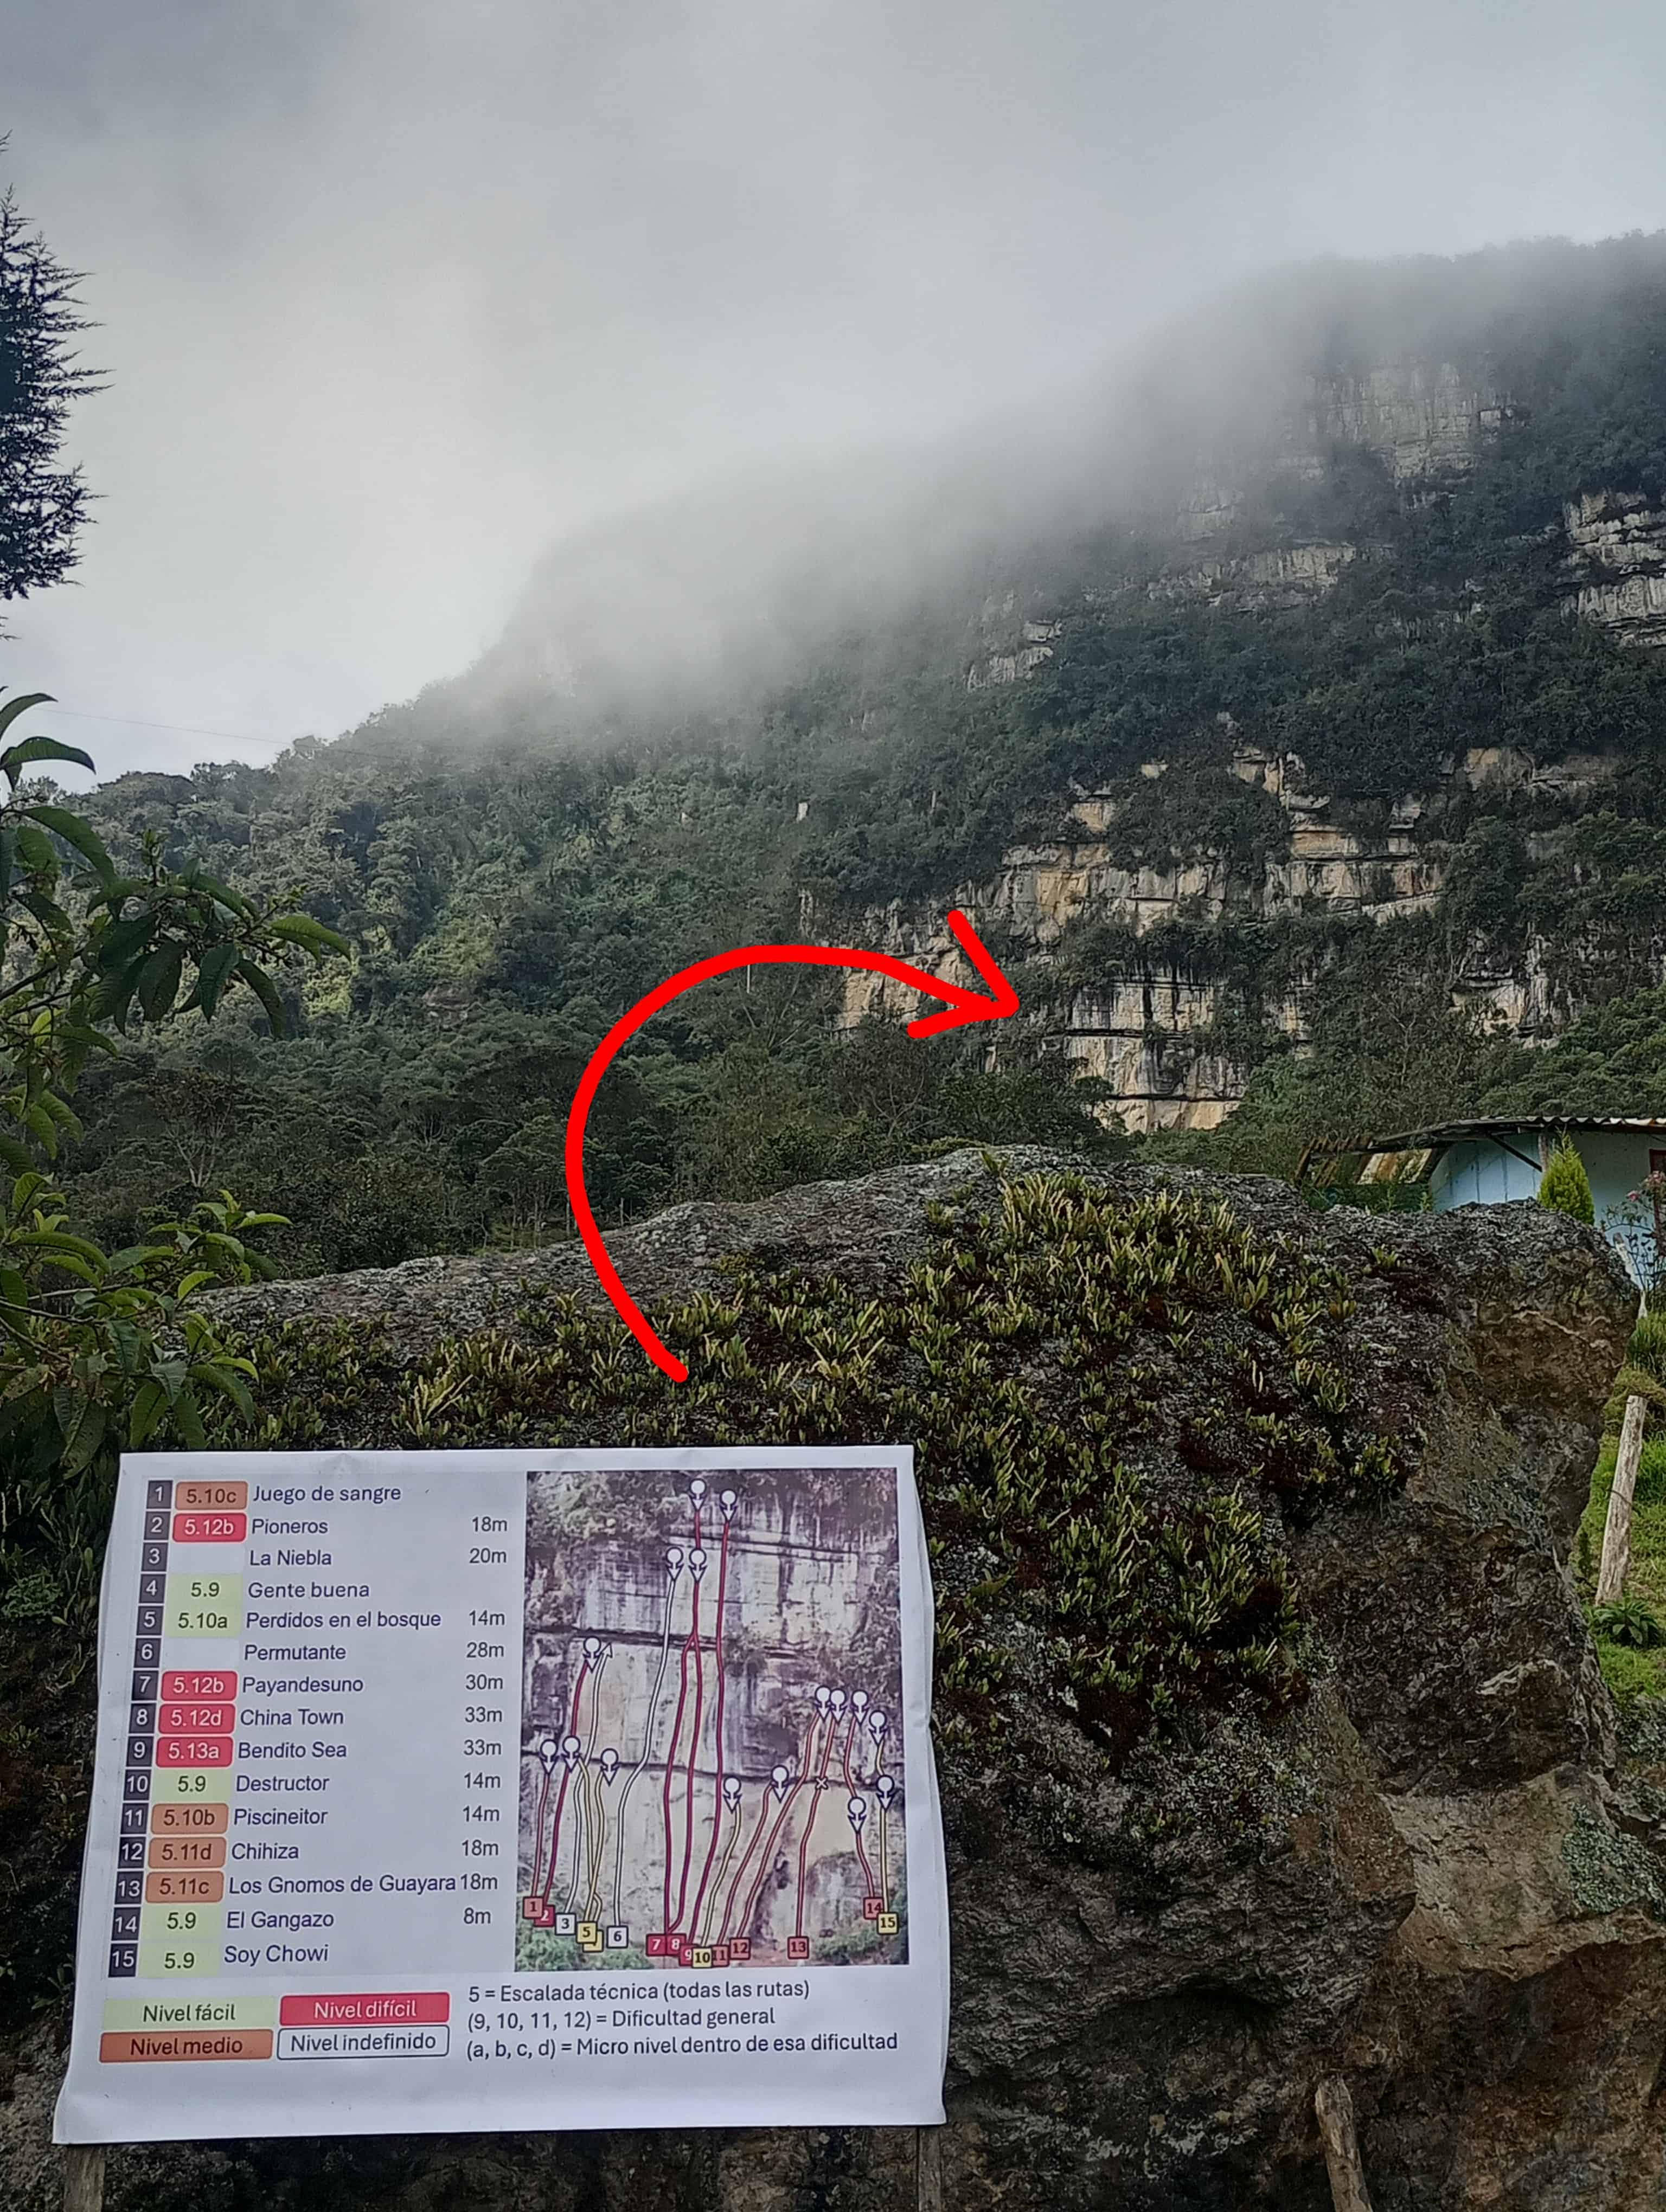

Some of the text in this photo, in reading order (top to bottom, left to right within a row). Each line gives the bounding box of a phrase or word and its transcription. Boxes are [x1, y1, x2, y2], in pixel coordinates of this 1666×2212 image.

[155, 1486, 401, 1503] 1 5.10c Juego de sangre
[151, 1517, 508, 1535] 2 5.12b Pioneros 18m
[149, 1548, 508, 1565] 3 La Niebla 20m
[146, 1580, 369, 1598] 4 5.9 Gente buena
[143, 1610, 505, 1629] 5 5.10a Perdidos en el bosque 14m
[140, 1642, 504, 1660] 6 Permutante 28m
[138, 1674, 503, 1695] 7 5.12b Payandesuno 30m
[136, 1707, 503, 1725] 8 5.12d China Town 33m
[133, 1739, 502, 1759] 9 5.13a Bendito Sea 33m
[127, 1773, 501, 1791] 10 5.9 Destructor 14m
[125, 1805, 500, 1825] 11 5.10b Piscineitor 14m
[121, 1840, 499, 1860] 12 5.11d Chihiza 18m
[118, 1874, 498, 1896] 13 5.11c Los Gnomos de Guayara 18m
[530, 1901, 537, 1911] 1
[867, 1902, 881, 1913] 14
[115, 1907, 491, 1932] 14 5.9 El Gangazo 8m
[542, 1911, 548, 1920] 2
[561, 1918, 569, 1928] 3
[881, 1918, 895, 1927] 15
[582, 1926, 591, 1936] 5
[613, 1931, 621, 1941] 6
[652, 1940, 661, 1950] 7
[672, 1938, 680, 1949] 8
[733, 1943, 747, 1952] 12
[791, 1941, 806, 1951] 13
[112, 1944, 329, 1968] 15 5.9 Soy Chowi
[685, 1949, 691, 1960] 9
[695, 1952, 710, 1962] 10
[713, 1950, 726, 1960] 11
[469, 1985, 480, 2002] 5
[501, 1983, 586, 2002] Escalada
[589, 1982, 658, 2000] técnica
[664, 1981, 721, 2002] (todas
[726, 1980, 752, 1997] las
[757, 1978, 810, 1999] rutas)
[143, 2003, 235, 2022] Nivel fácil
[314, 1999, 417, 2018] Nivel difícil
[468, 2013, 491, 2033] (9,
[497, 2013, 524, 2031] 10,
[531, 2012, 558, 2030] 11,
[565, 2010, 592, 2030] 12)
[612, 2009, 702, 2027] Dificultad
[707, 2008, 775, 2028] general
[131, 2036, 242, 2055] Nivel medio
[291, 2032, 436, 2051] Nivel indefinido
[466, 2041, 490, 2060] (a,
[495, 2039, 513, 2059] b,
[517, 2043, 534, 2058] c,
[539, 2039, 556, 2059] d)
[577, 2037, 628, 2056] Micro
[633, 2035, 677, 2054] nivel
[682, 2035, 741, 2053] dentro
[746, 2034, 770, 2052] de
[773, 2037, 805, 2051] esa
[811, 2032, 898, 2051] dificultad
